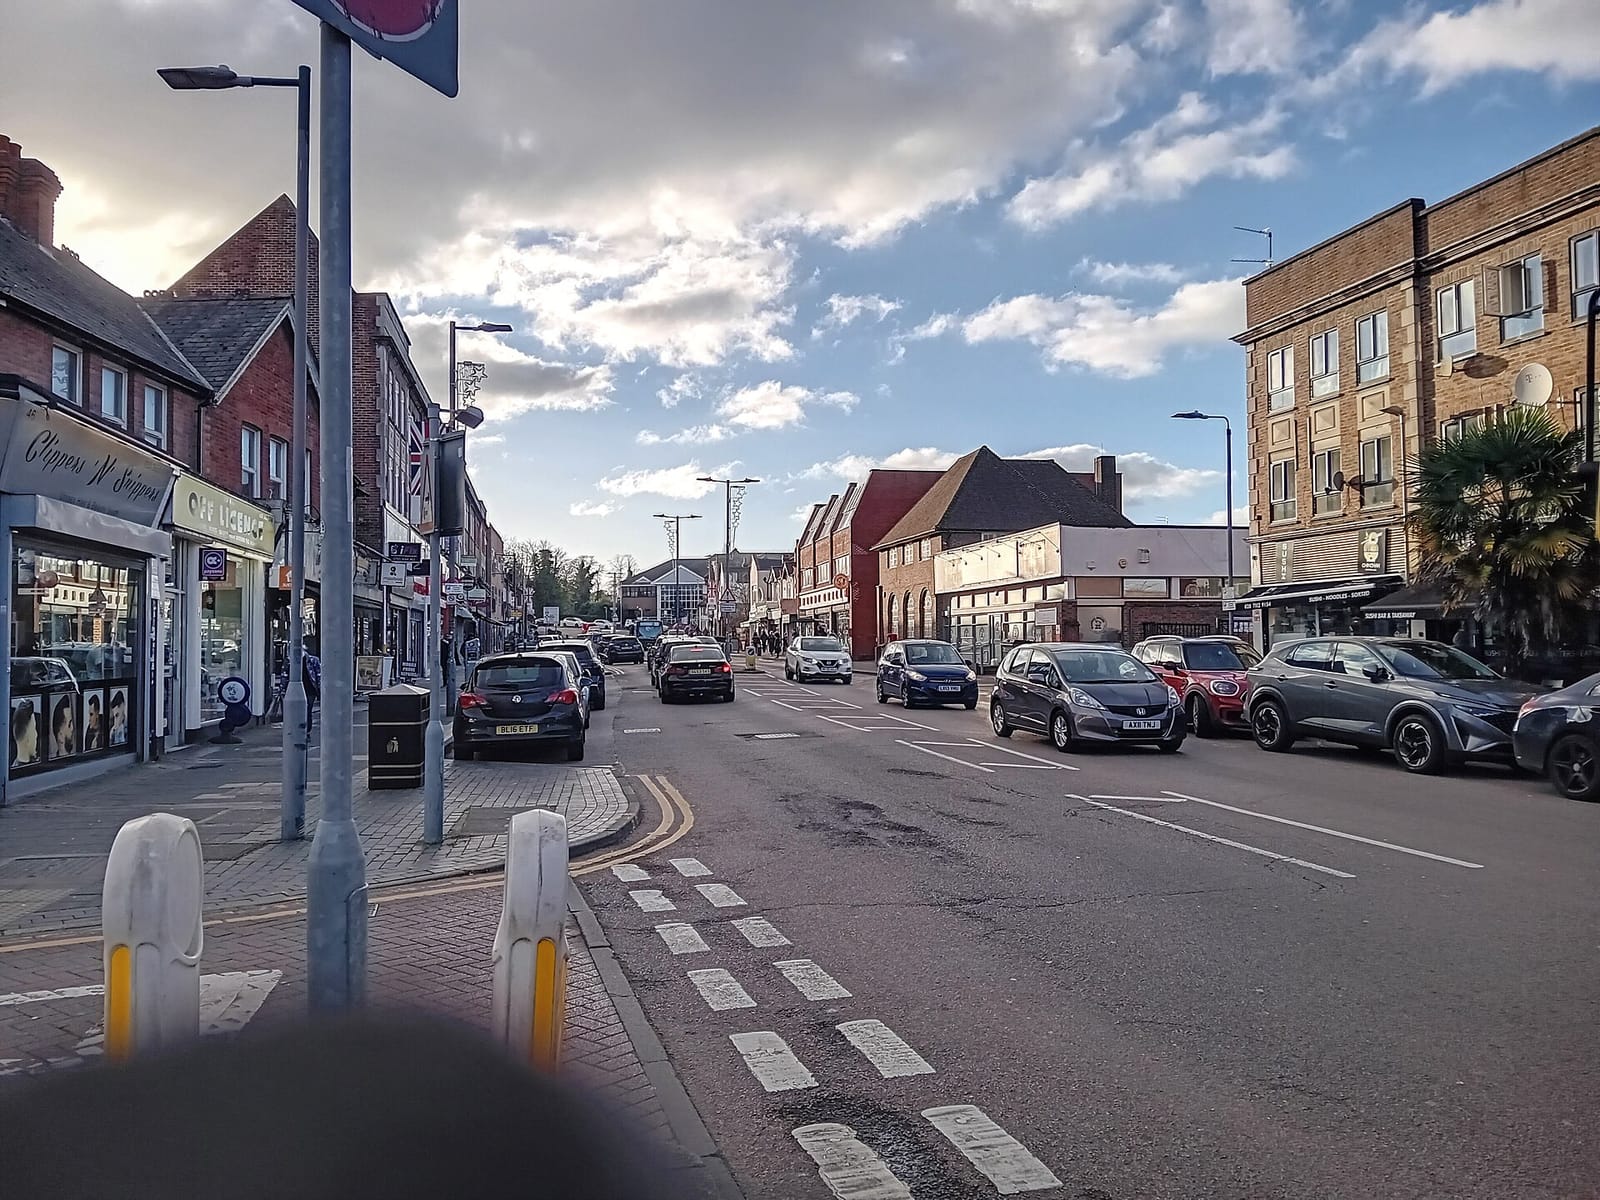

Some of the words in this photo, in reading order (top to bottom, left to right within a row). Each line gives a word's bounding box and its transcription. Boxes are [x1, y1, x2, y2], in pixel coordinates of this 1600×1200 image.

[25, 430, 86, 474] Clippers
[113, 468, 160, 502] Snippers
[188, 492, 214, 522] OFF
[1325, 593, 1348, 601] NOODLES
[500, 725, 517, 734] BL16
[519, 724, 534, 733] ETF
[1143, 721, 1156, 729] TNJ
